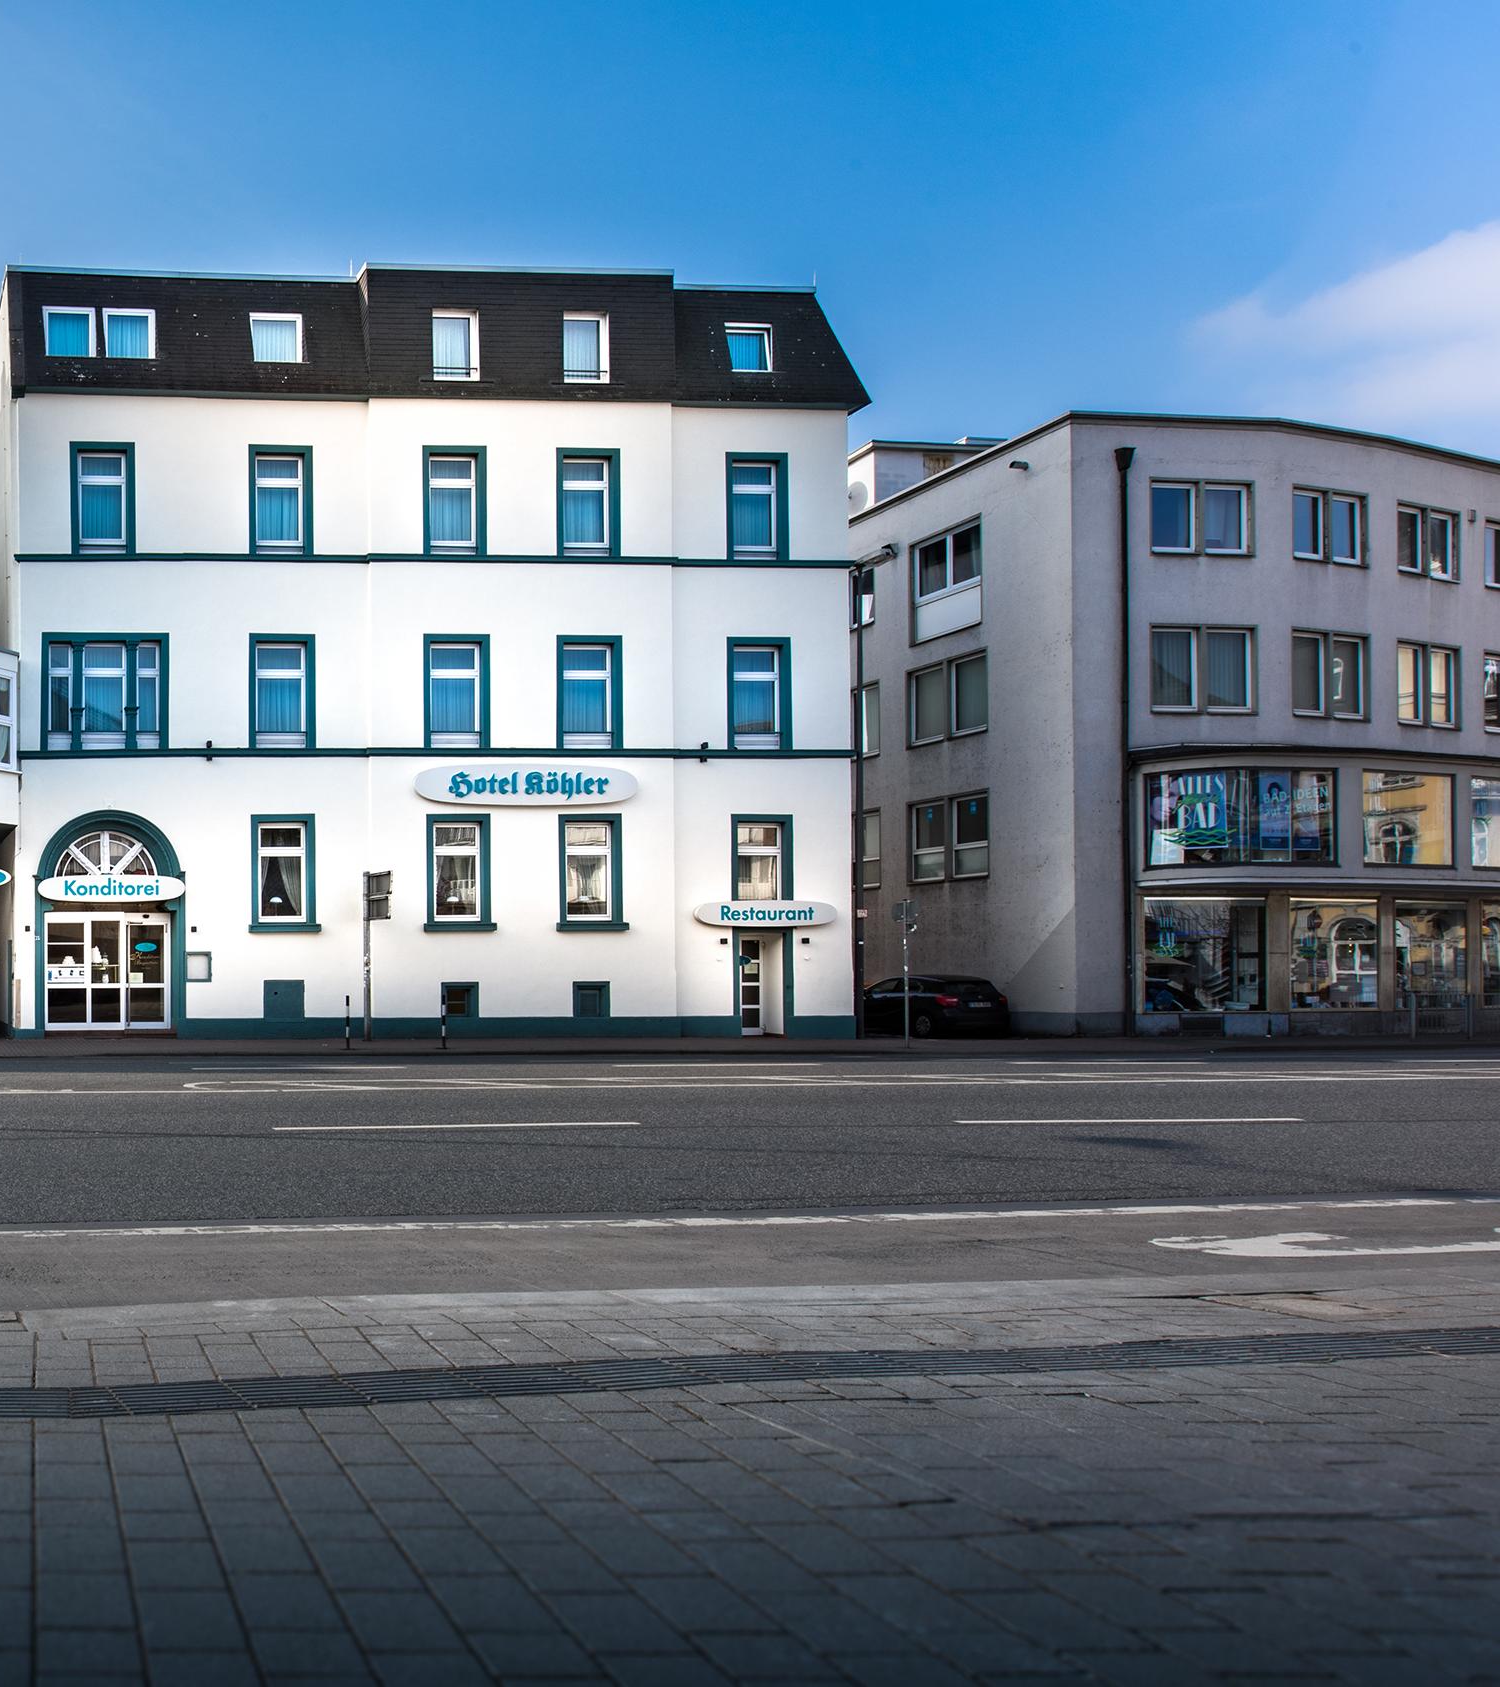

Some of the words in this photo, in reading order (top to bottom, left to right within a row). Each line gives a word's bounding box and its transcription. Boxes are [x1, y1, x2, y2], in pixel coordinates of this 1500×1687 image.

[449, 771, 518, 799] Hotel
[525, 770, 610, 801] Köhler
[1177, 802, 1222, 830] BAD
[64, 878, 160, 897] Konditorei
[720, 905, 815, 921] Restaurant
